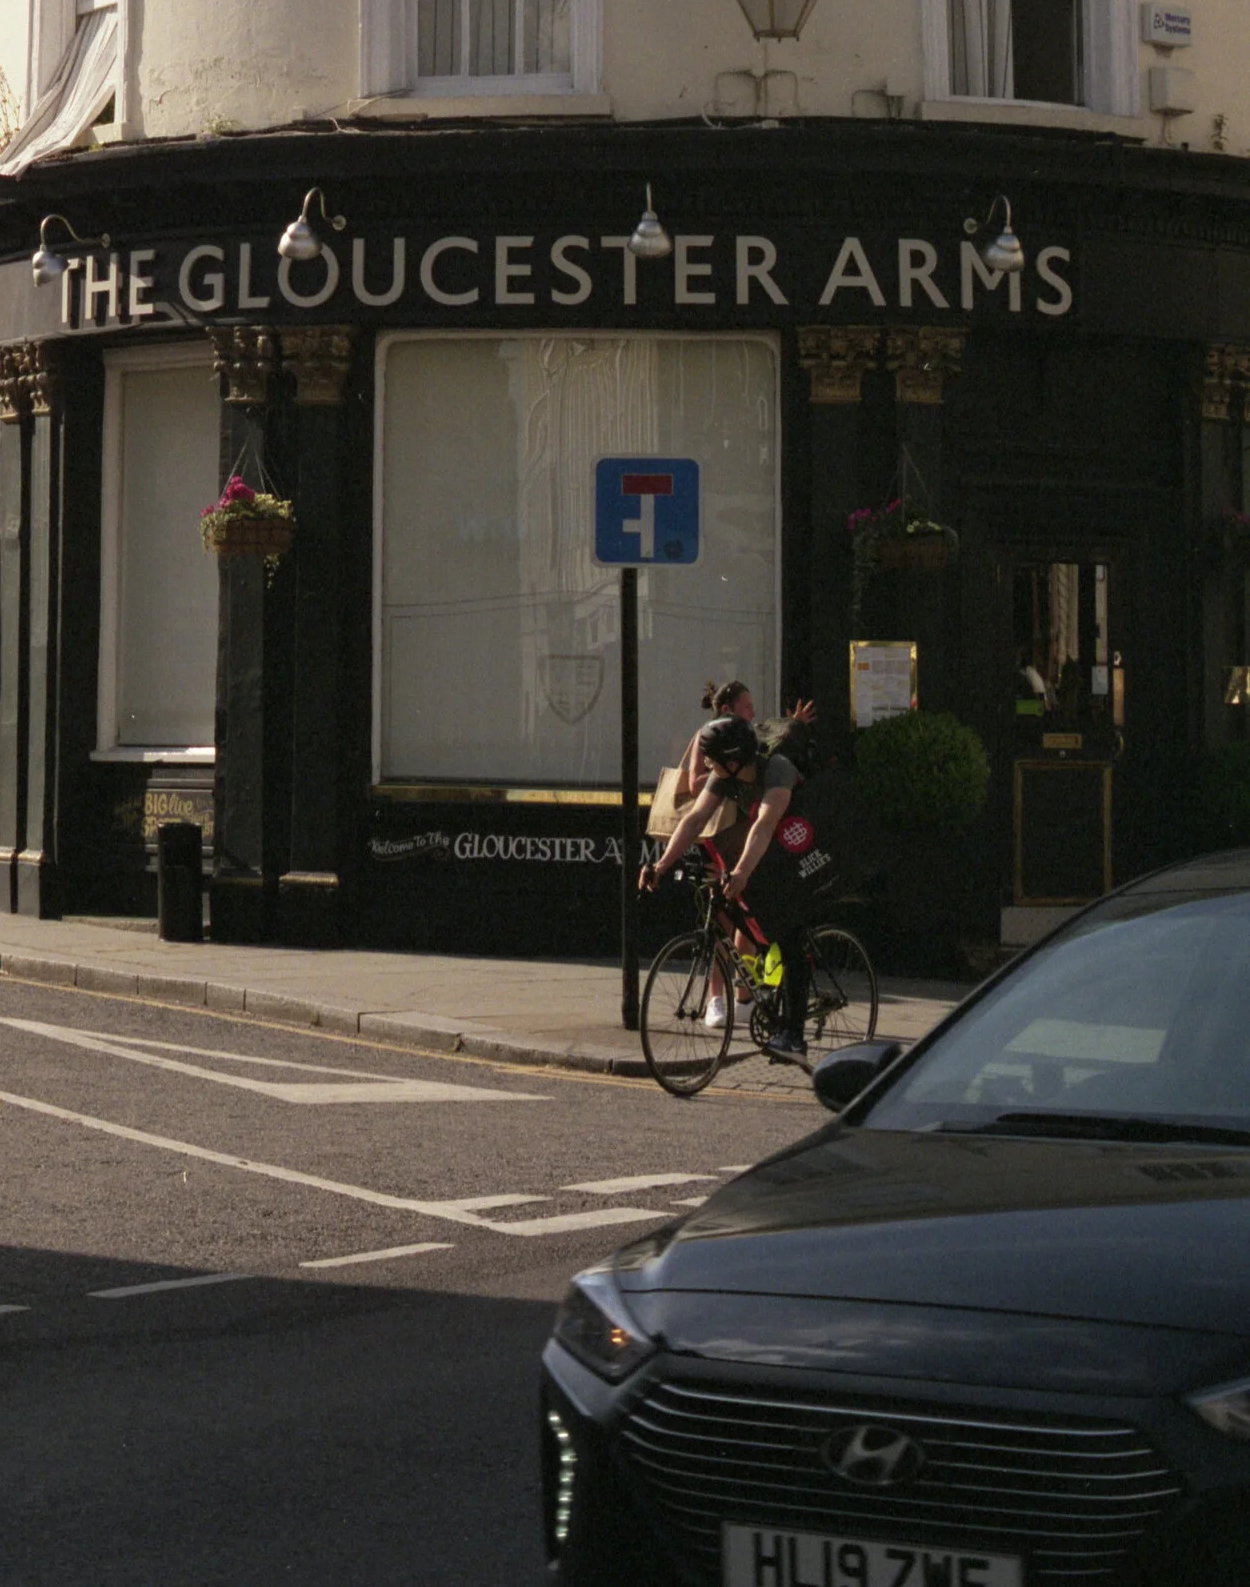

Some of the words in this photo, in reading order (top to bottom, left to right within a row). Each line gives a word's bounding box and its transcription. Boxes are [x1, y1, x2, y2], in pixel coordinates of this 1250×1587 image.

[59, 249, 156, 324] THE
[177, 234, 790, 313] GLOUCESTER
[818, 236, 1074, 315] ARMS
[144, 792, 168, 815] BIG
[368, 837, 413, 854] Welcome
[454, 831, 599, 862] GLOUCESTER
[604, 837, 668, 865] AM
[753, 1533, 869, 1587] HL19
